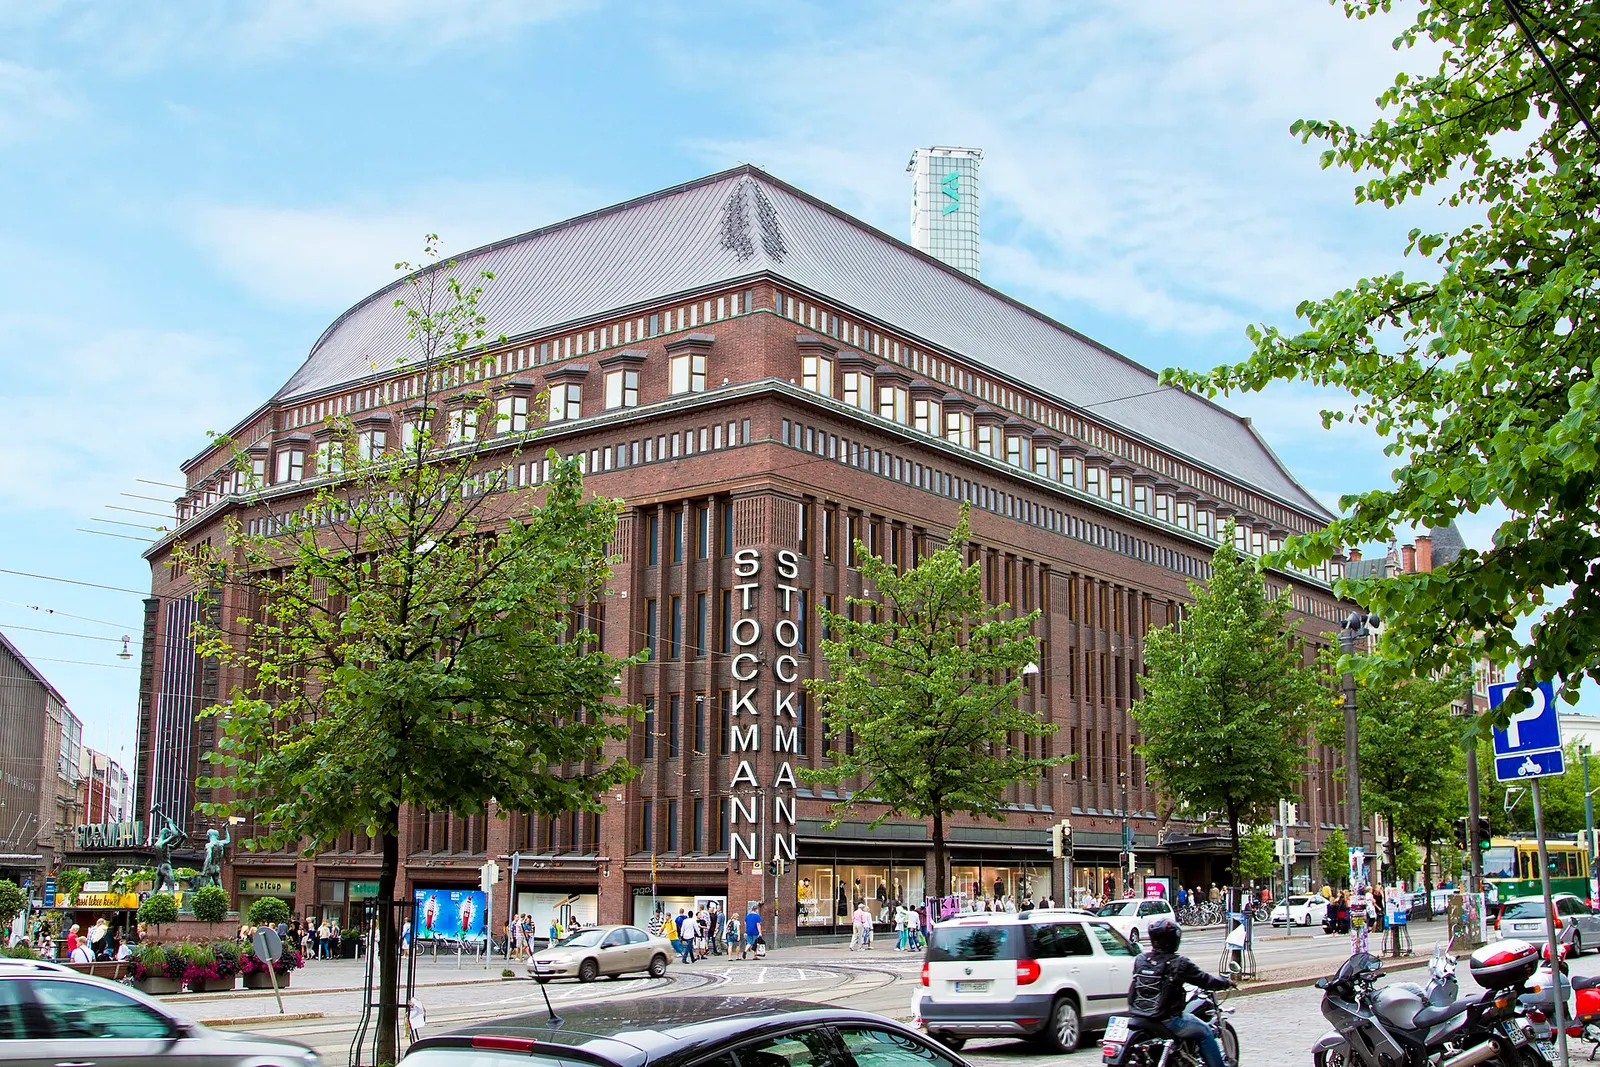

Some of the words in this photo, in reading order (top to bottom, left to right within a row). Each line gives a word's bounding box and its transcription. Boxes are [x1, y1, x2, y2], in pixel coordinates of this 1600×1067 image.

[730, 549, 760, 860] STOCKMANN
[774, 549, 799, 860] STOCKMANN
[1502, 687, 1546, 748] P
[255, 881, 281, 891] netcup
